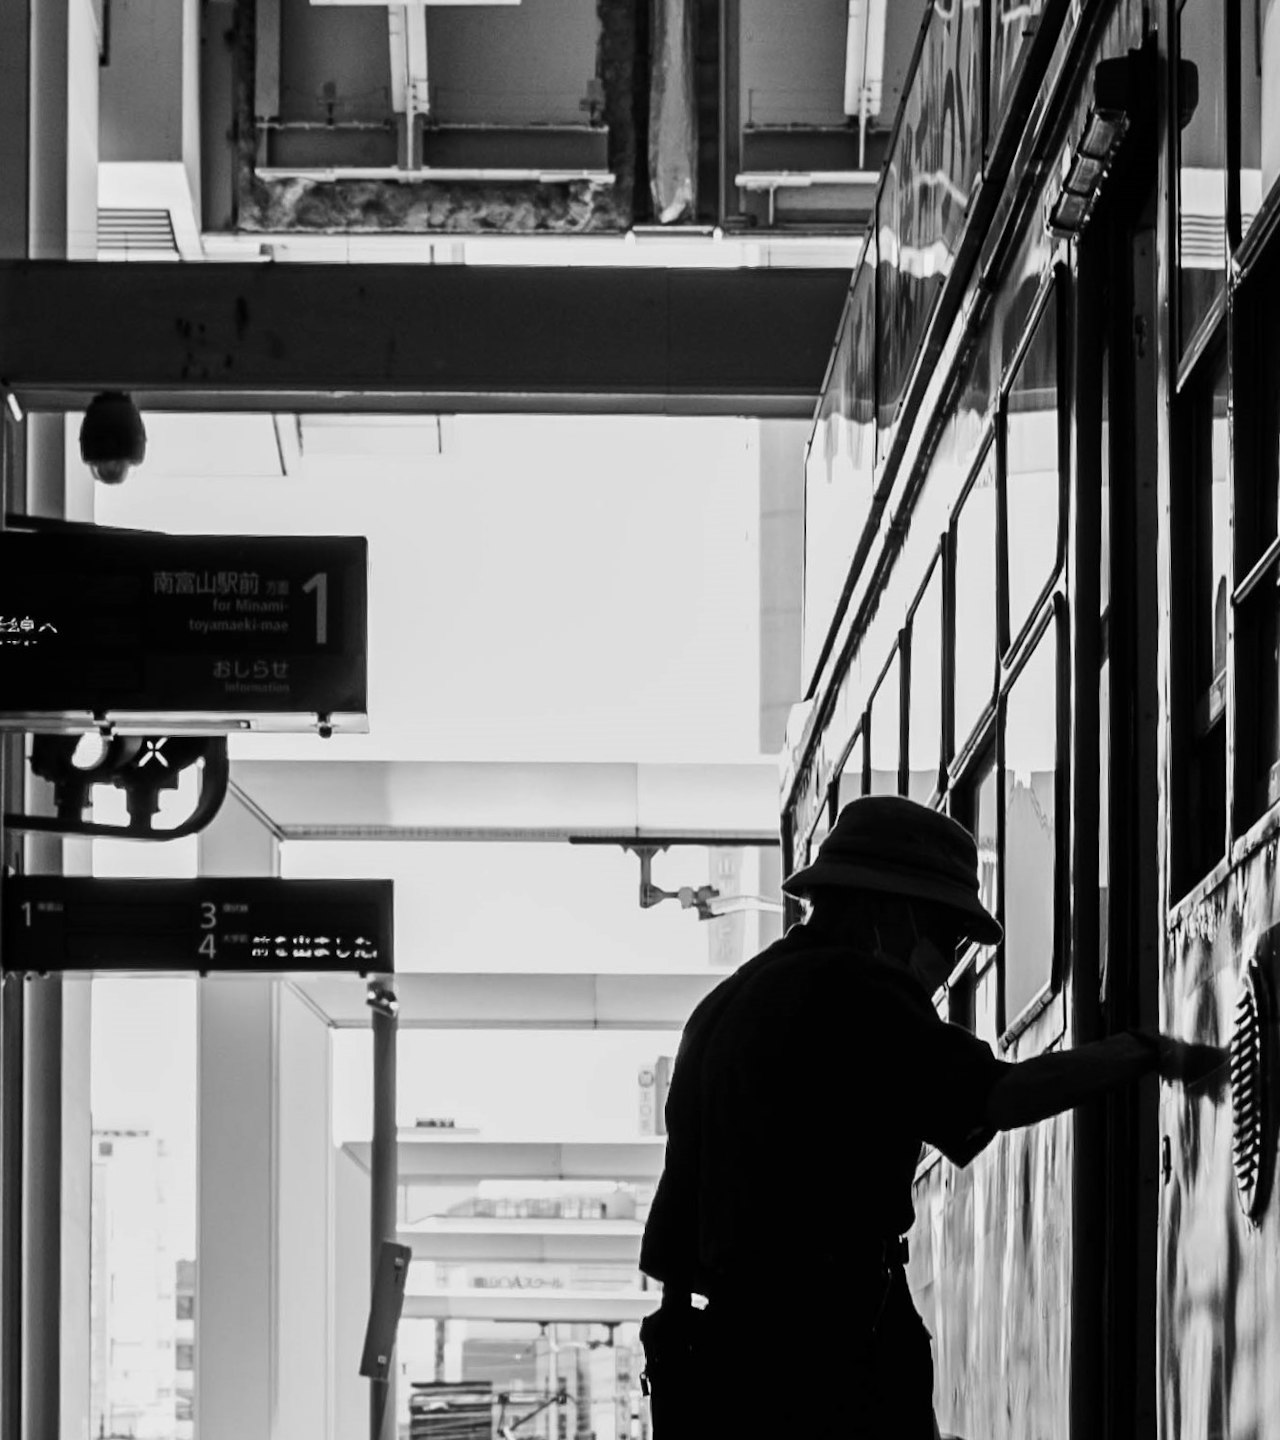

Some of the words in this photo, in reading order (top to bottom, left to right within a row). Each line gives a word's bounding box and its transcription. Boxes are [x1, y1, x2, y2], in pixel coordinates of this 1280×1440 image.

[152, 570, 259, 595] 南富山駅前
[212, 598, 232, 612] for
[302, 572, 328, 645] 1
[189, 616, 289, 635] toyamaeki-mae
[213, 659, 289, 679] おしらせ
[21, 901, 31, 927] 1
[200, 901, 217, 930] 3
[198, 933, 217, 960] 4
